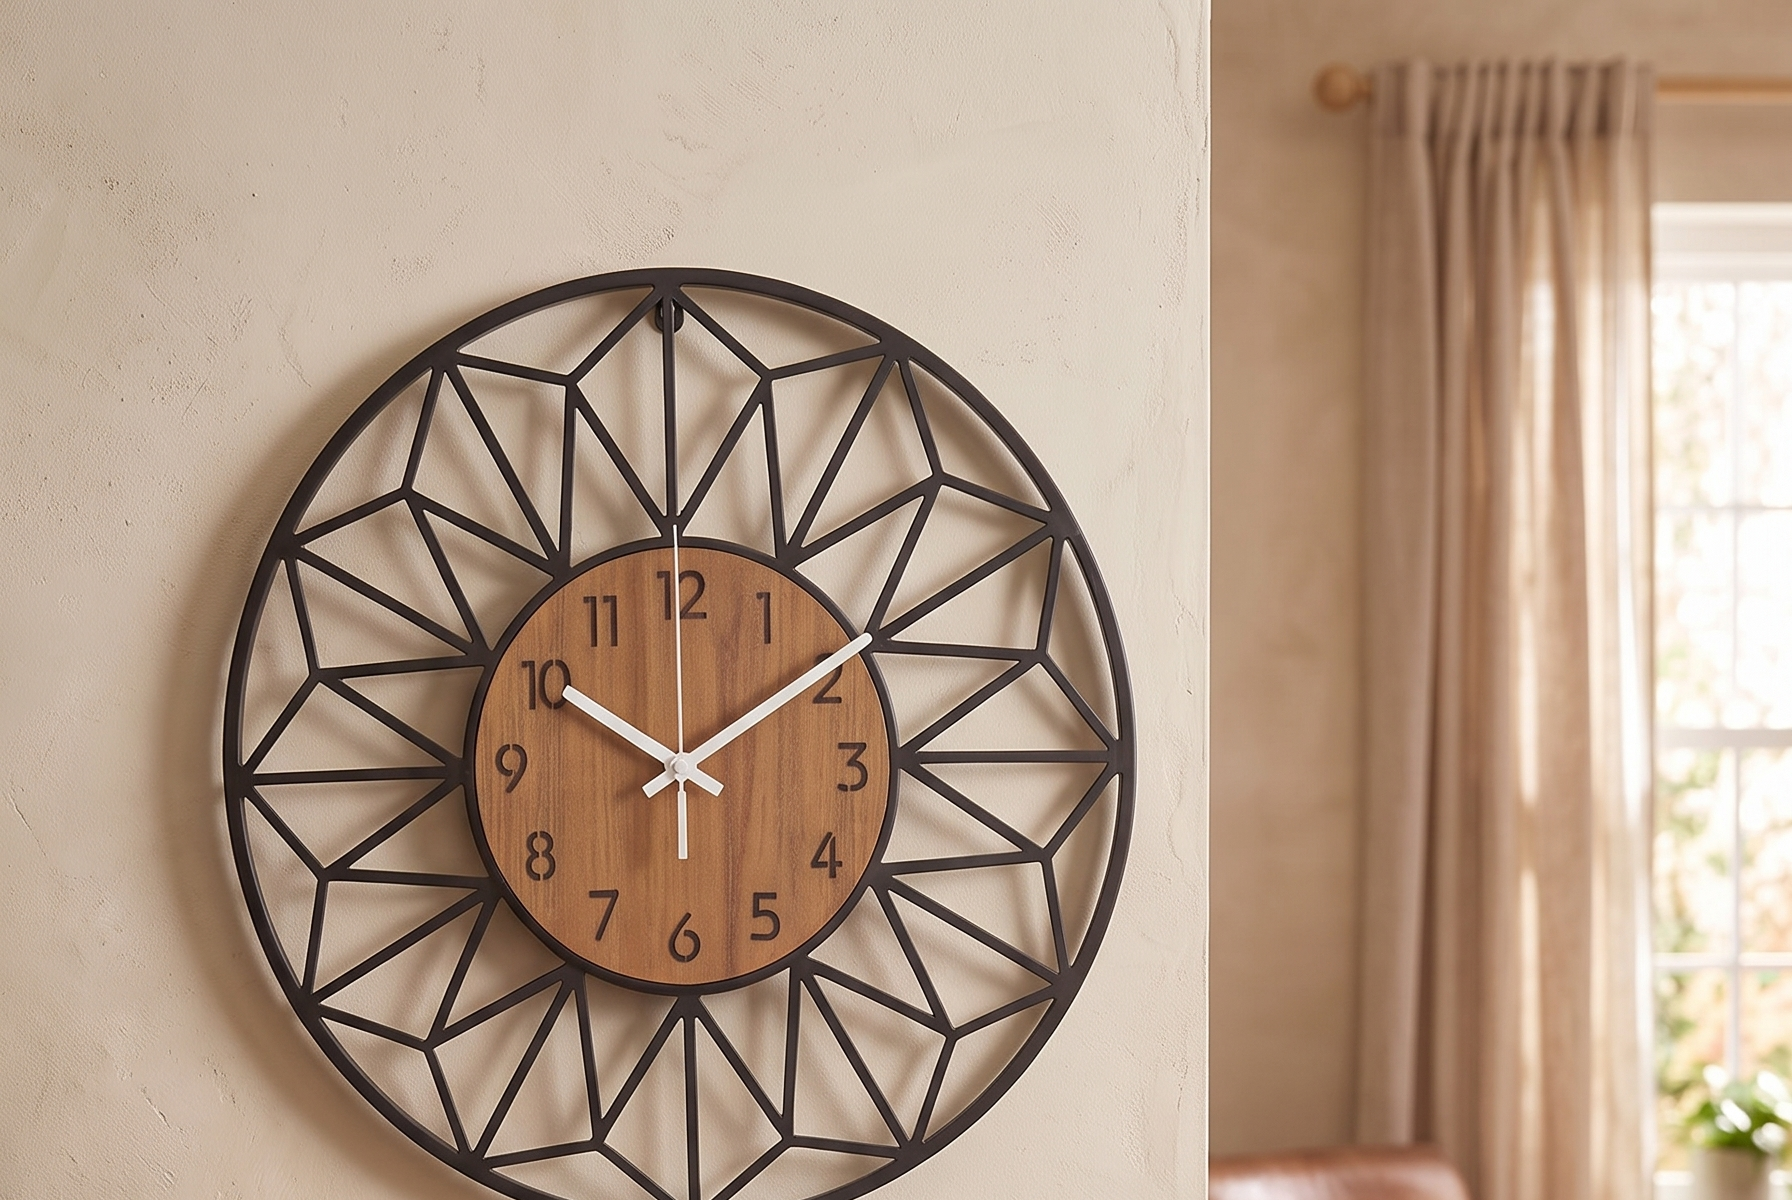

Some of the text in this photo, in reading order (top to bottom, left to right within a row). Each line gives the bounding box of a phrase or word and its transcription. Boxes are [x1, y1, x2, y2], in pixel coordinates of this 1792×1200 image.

[657, 570, 708, 620] 12
[756, 592, 771, 644] 1
[583, 595, 618, 648] 11
[521, 659, 571, 711] 10
[812, 652, 843, 704] 2
[495, 743, 527, 793] 9
[837, 742, 868, 792] 3
[525, 831, 556, 881] 8
[811, 832, 843, 879] 4
[588, 889, 619, 941] 7
[668, 912, 701, 963] 6
[750, 892, 781, 941] 5
